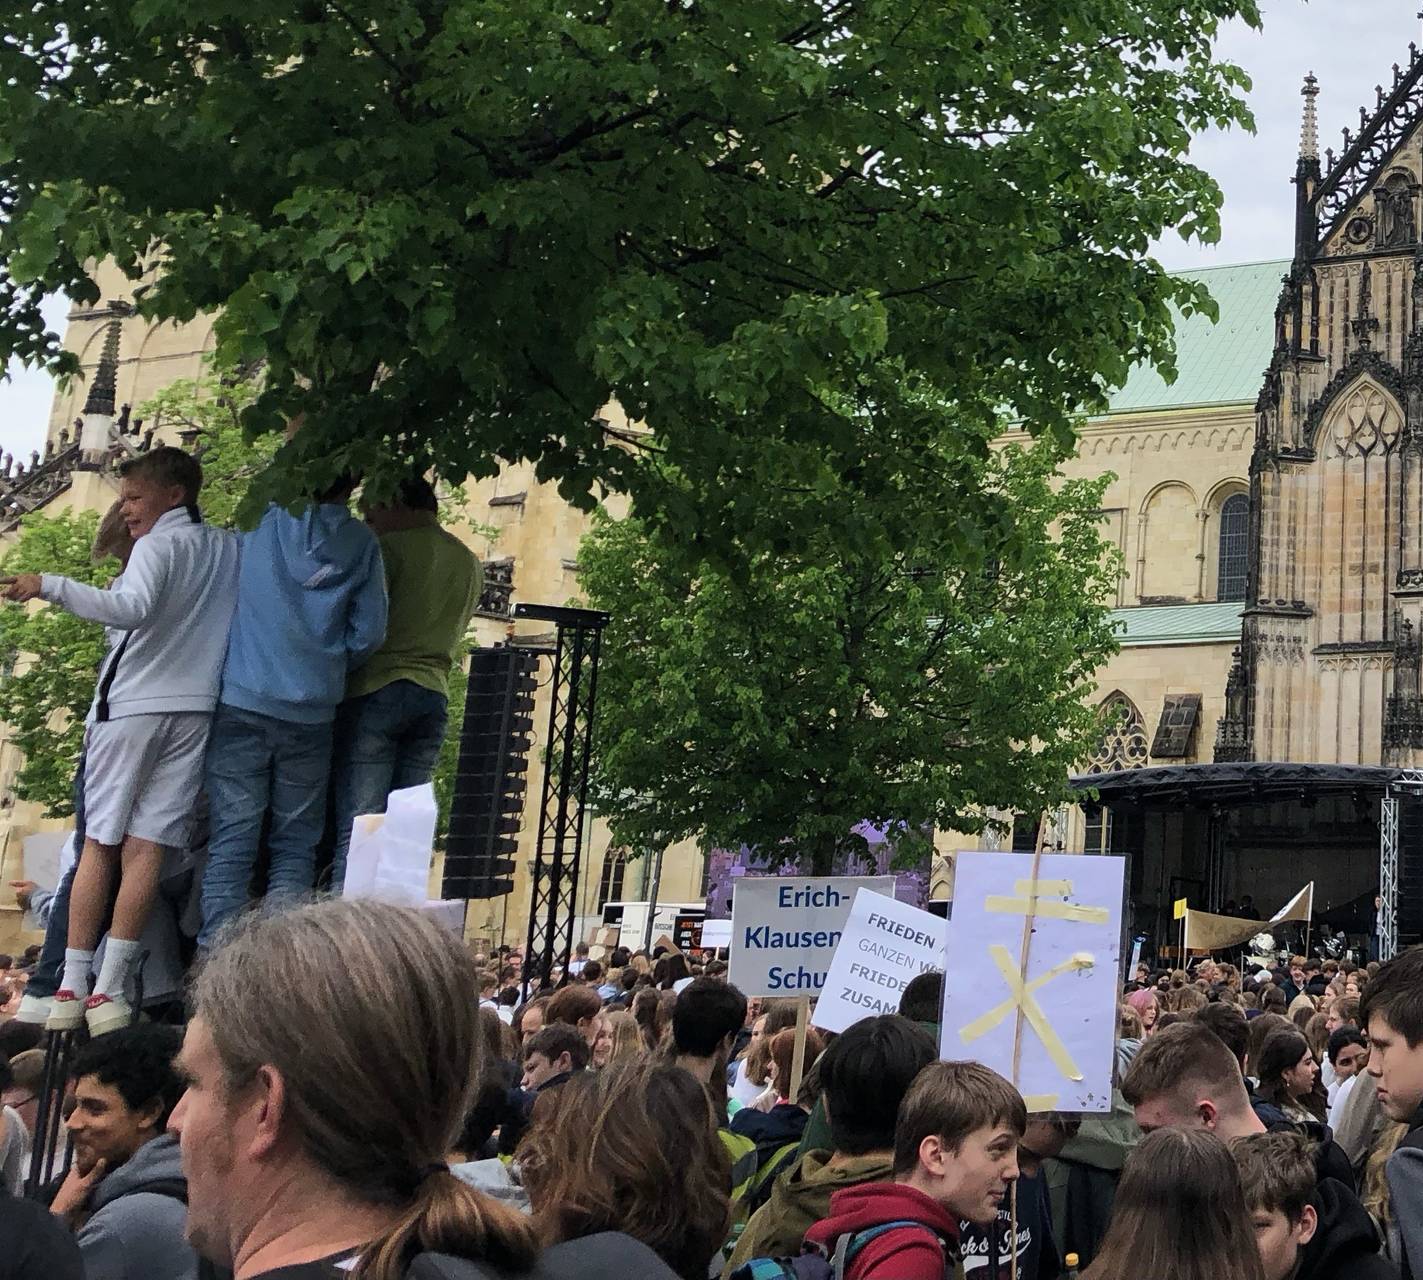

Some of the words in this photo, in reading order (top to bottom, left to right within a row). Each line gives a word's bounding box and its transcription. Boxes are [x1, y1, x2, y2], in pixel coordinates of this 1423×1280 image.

[779, 885, 850, 907] Erich-
[745, 925, 842, 948] Klausen
[868, 912, 936, 949] FRIEDEN
[858, 938, 915, 969] GANZEN
[768, 966, 827, 989] Schu
[850, 963, 909, 992] FRIEDE
[840, 987, 897, 1014] ZUSAM
[960, 1235, 978, 1255] ck
